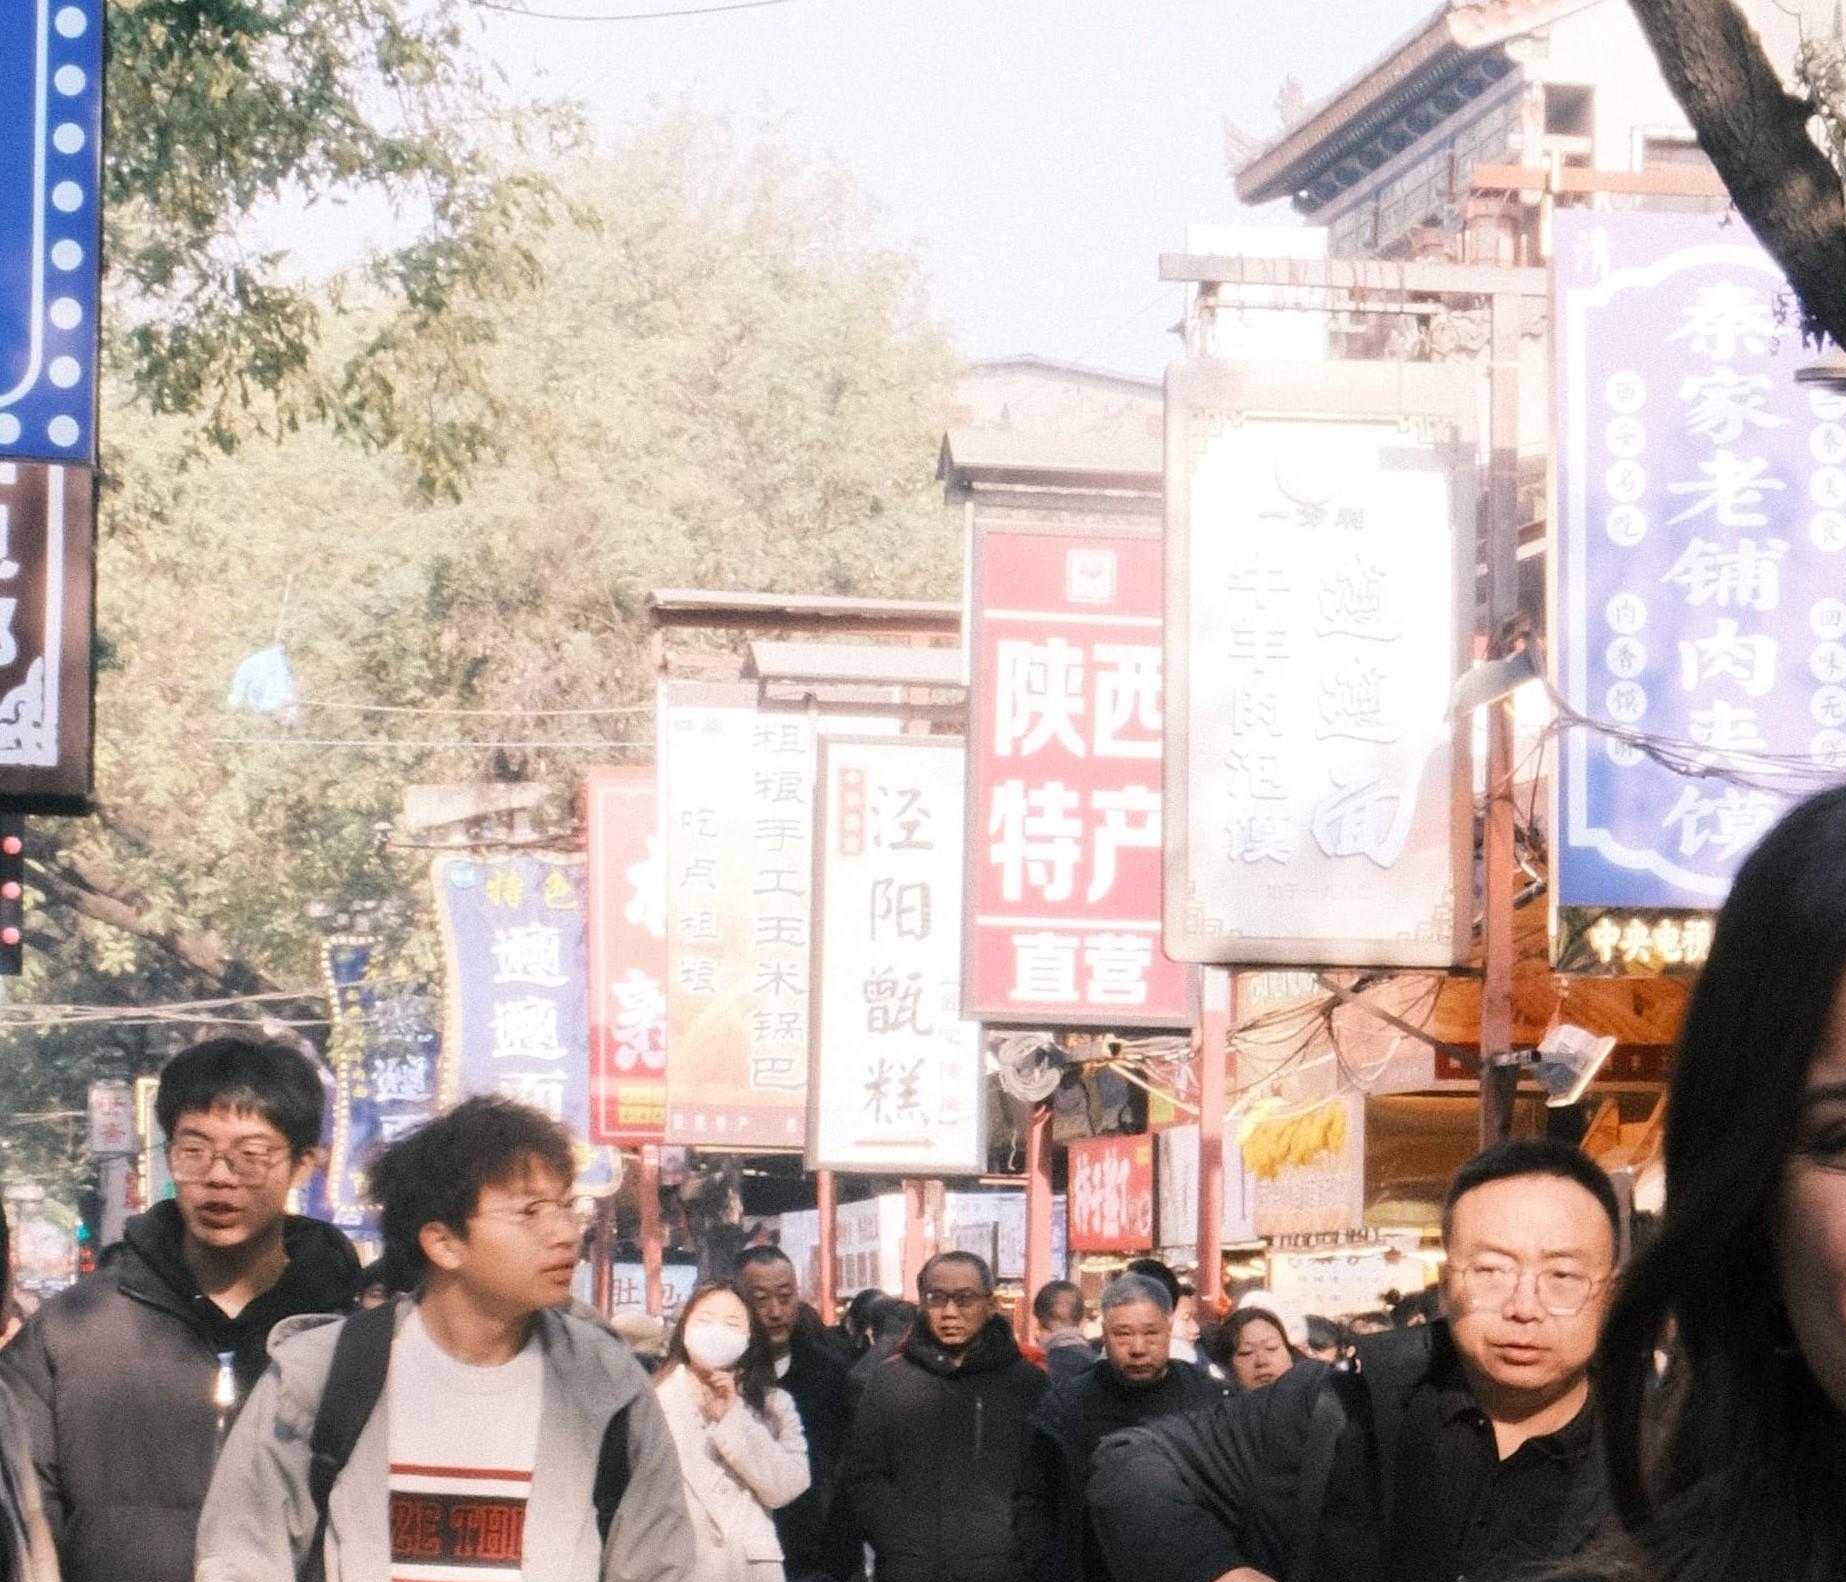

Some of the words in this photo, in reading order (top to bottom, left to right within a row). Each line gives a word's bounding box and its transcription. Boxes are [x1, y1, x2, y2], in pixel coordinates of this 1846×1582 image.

[993, 636, 1162, 758] 陕西
[988, 779, 1162, 903] 特产
[751, 722, 807, 1093] 粗粮手工玉米锅巴
[862, 783, 935, 1128] 泾阳甑糕
[1010, 932, 1153, 1004] 直营
